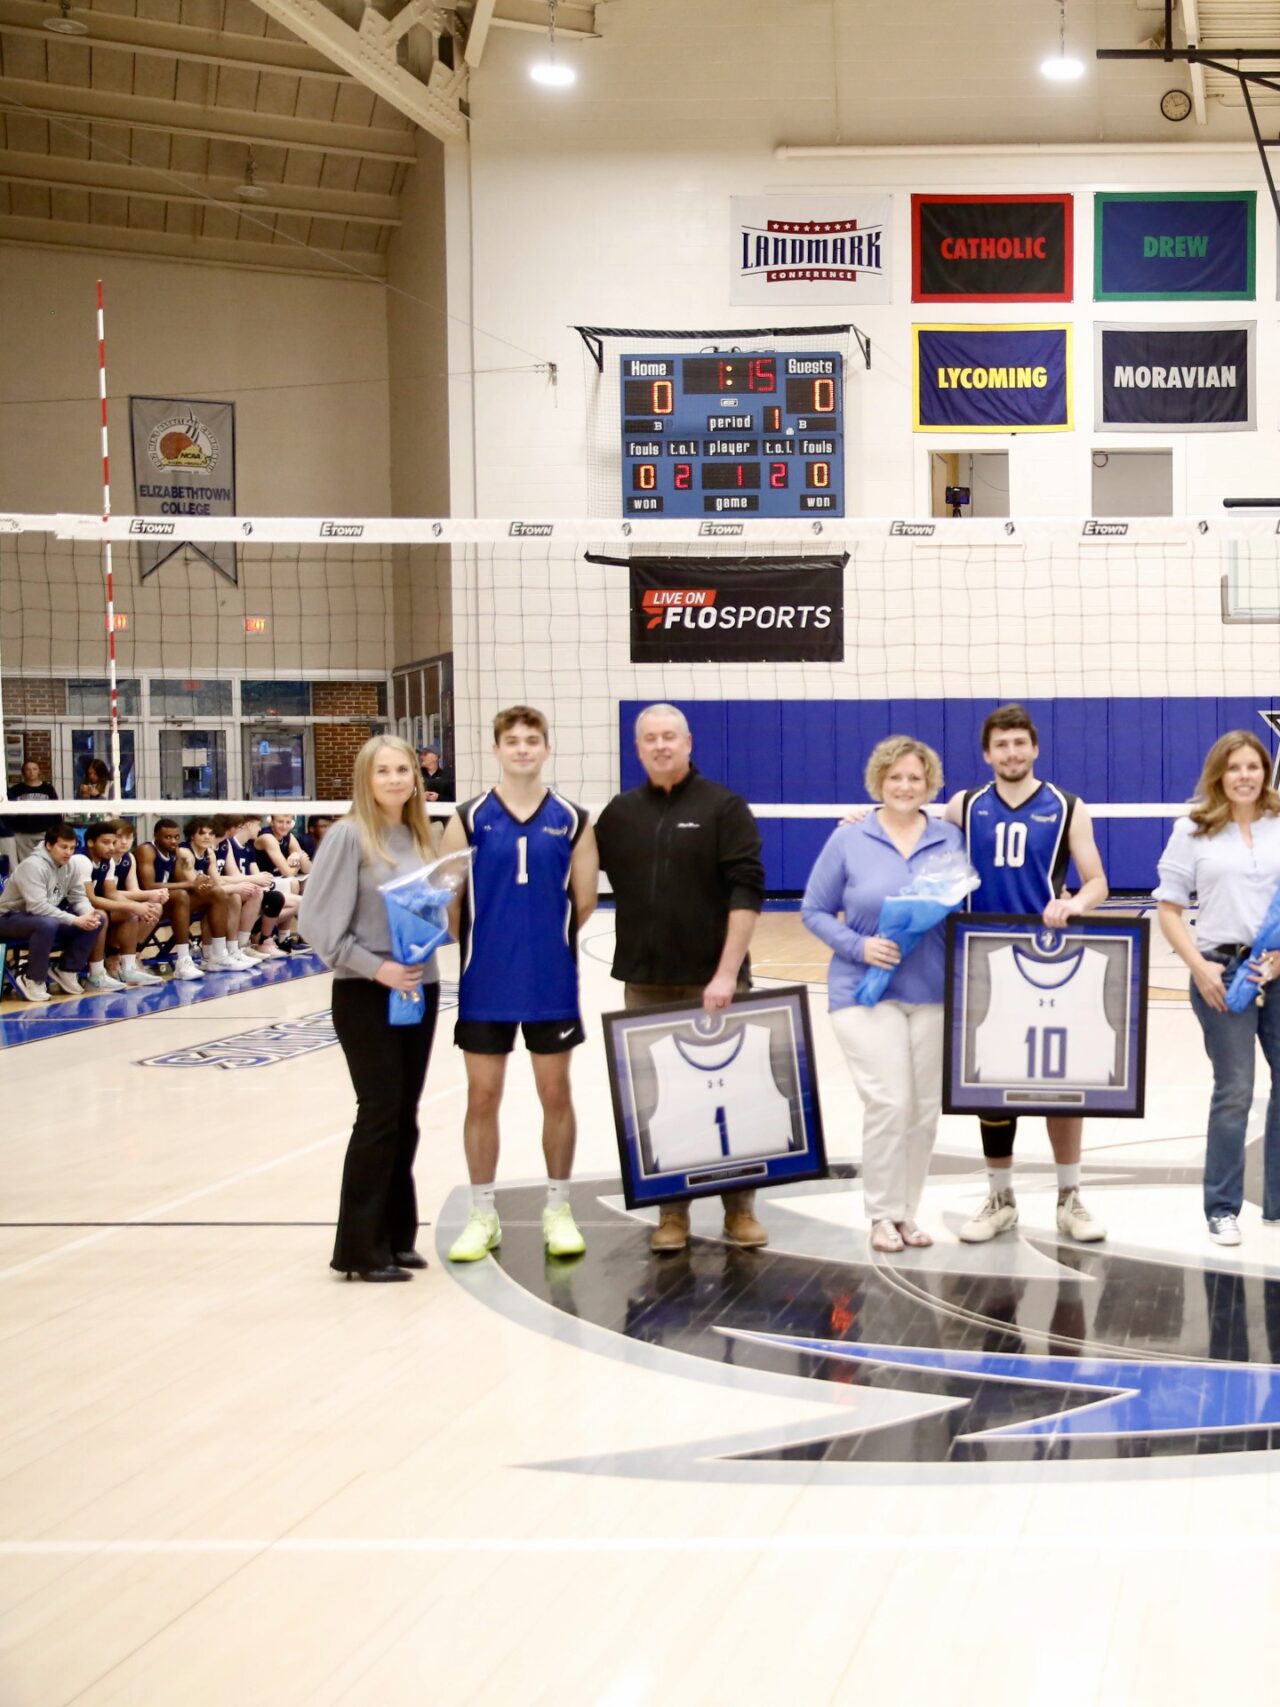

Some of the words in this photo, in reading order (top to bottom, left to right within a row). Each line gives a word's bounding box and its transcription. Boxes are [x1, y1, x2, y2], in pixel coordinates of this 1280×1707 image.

[741, 231, 882, 270] LANDMARK
[940, 236, 1047, 261] CATHOLIC
[1143, 236, 1209, 258] DREW
[771, 271, 853, 280] CONFERENCE
[631, 361, 667, 377] Home
[788, 359, 833, 374] Guests
[1114, 365, 1236, 389] MORAVIAN
[938, 367, 1048, 389] LYCOMING
[653, 381, 673, 414] 0
[814, 379, 834, 412] 0
[710, 416, 751, 432] period
[774, 408, 780, 430] 1
[630, 442, 659, 456] fouls
[709, 441, 750, 456] player
[803, 440, 833, 453] fouls
[640, 465, 655, 489] 0
[674, 464, 690, 488] 2
[736, 465, 743, 487] 1
[770, 463, 787, 487] 2
[813, 463, 828, 486] 0
[139, 484, 230, 501] ELIZABETHTOWN
[715, 496, 748, 511] game
[807, 496, 830, 507] won
[161, 503, 210, 516] COLLEGE
[633, 499, 657, 510] won
[653, 592, 682, 605] LIVE
[685, 592, 706, 605] ON
[664, 605, 832, 629] FLOSPORTS
[994, 821, 1028, 868] 10
[516, 836, 529, 885] 1
[1024, 1026, 1068, 1079] 10
[714, 1106, 731, 1157] 1
